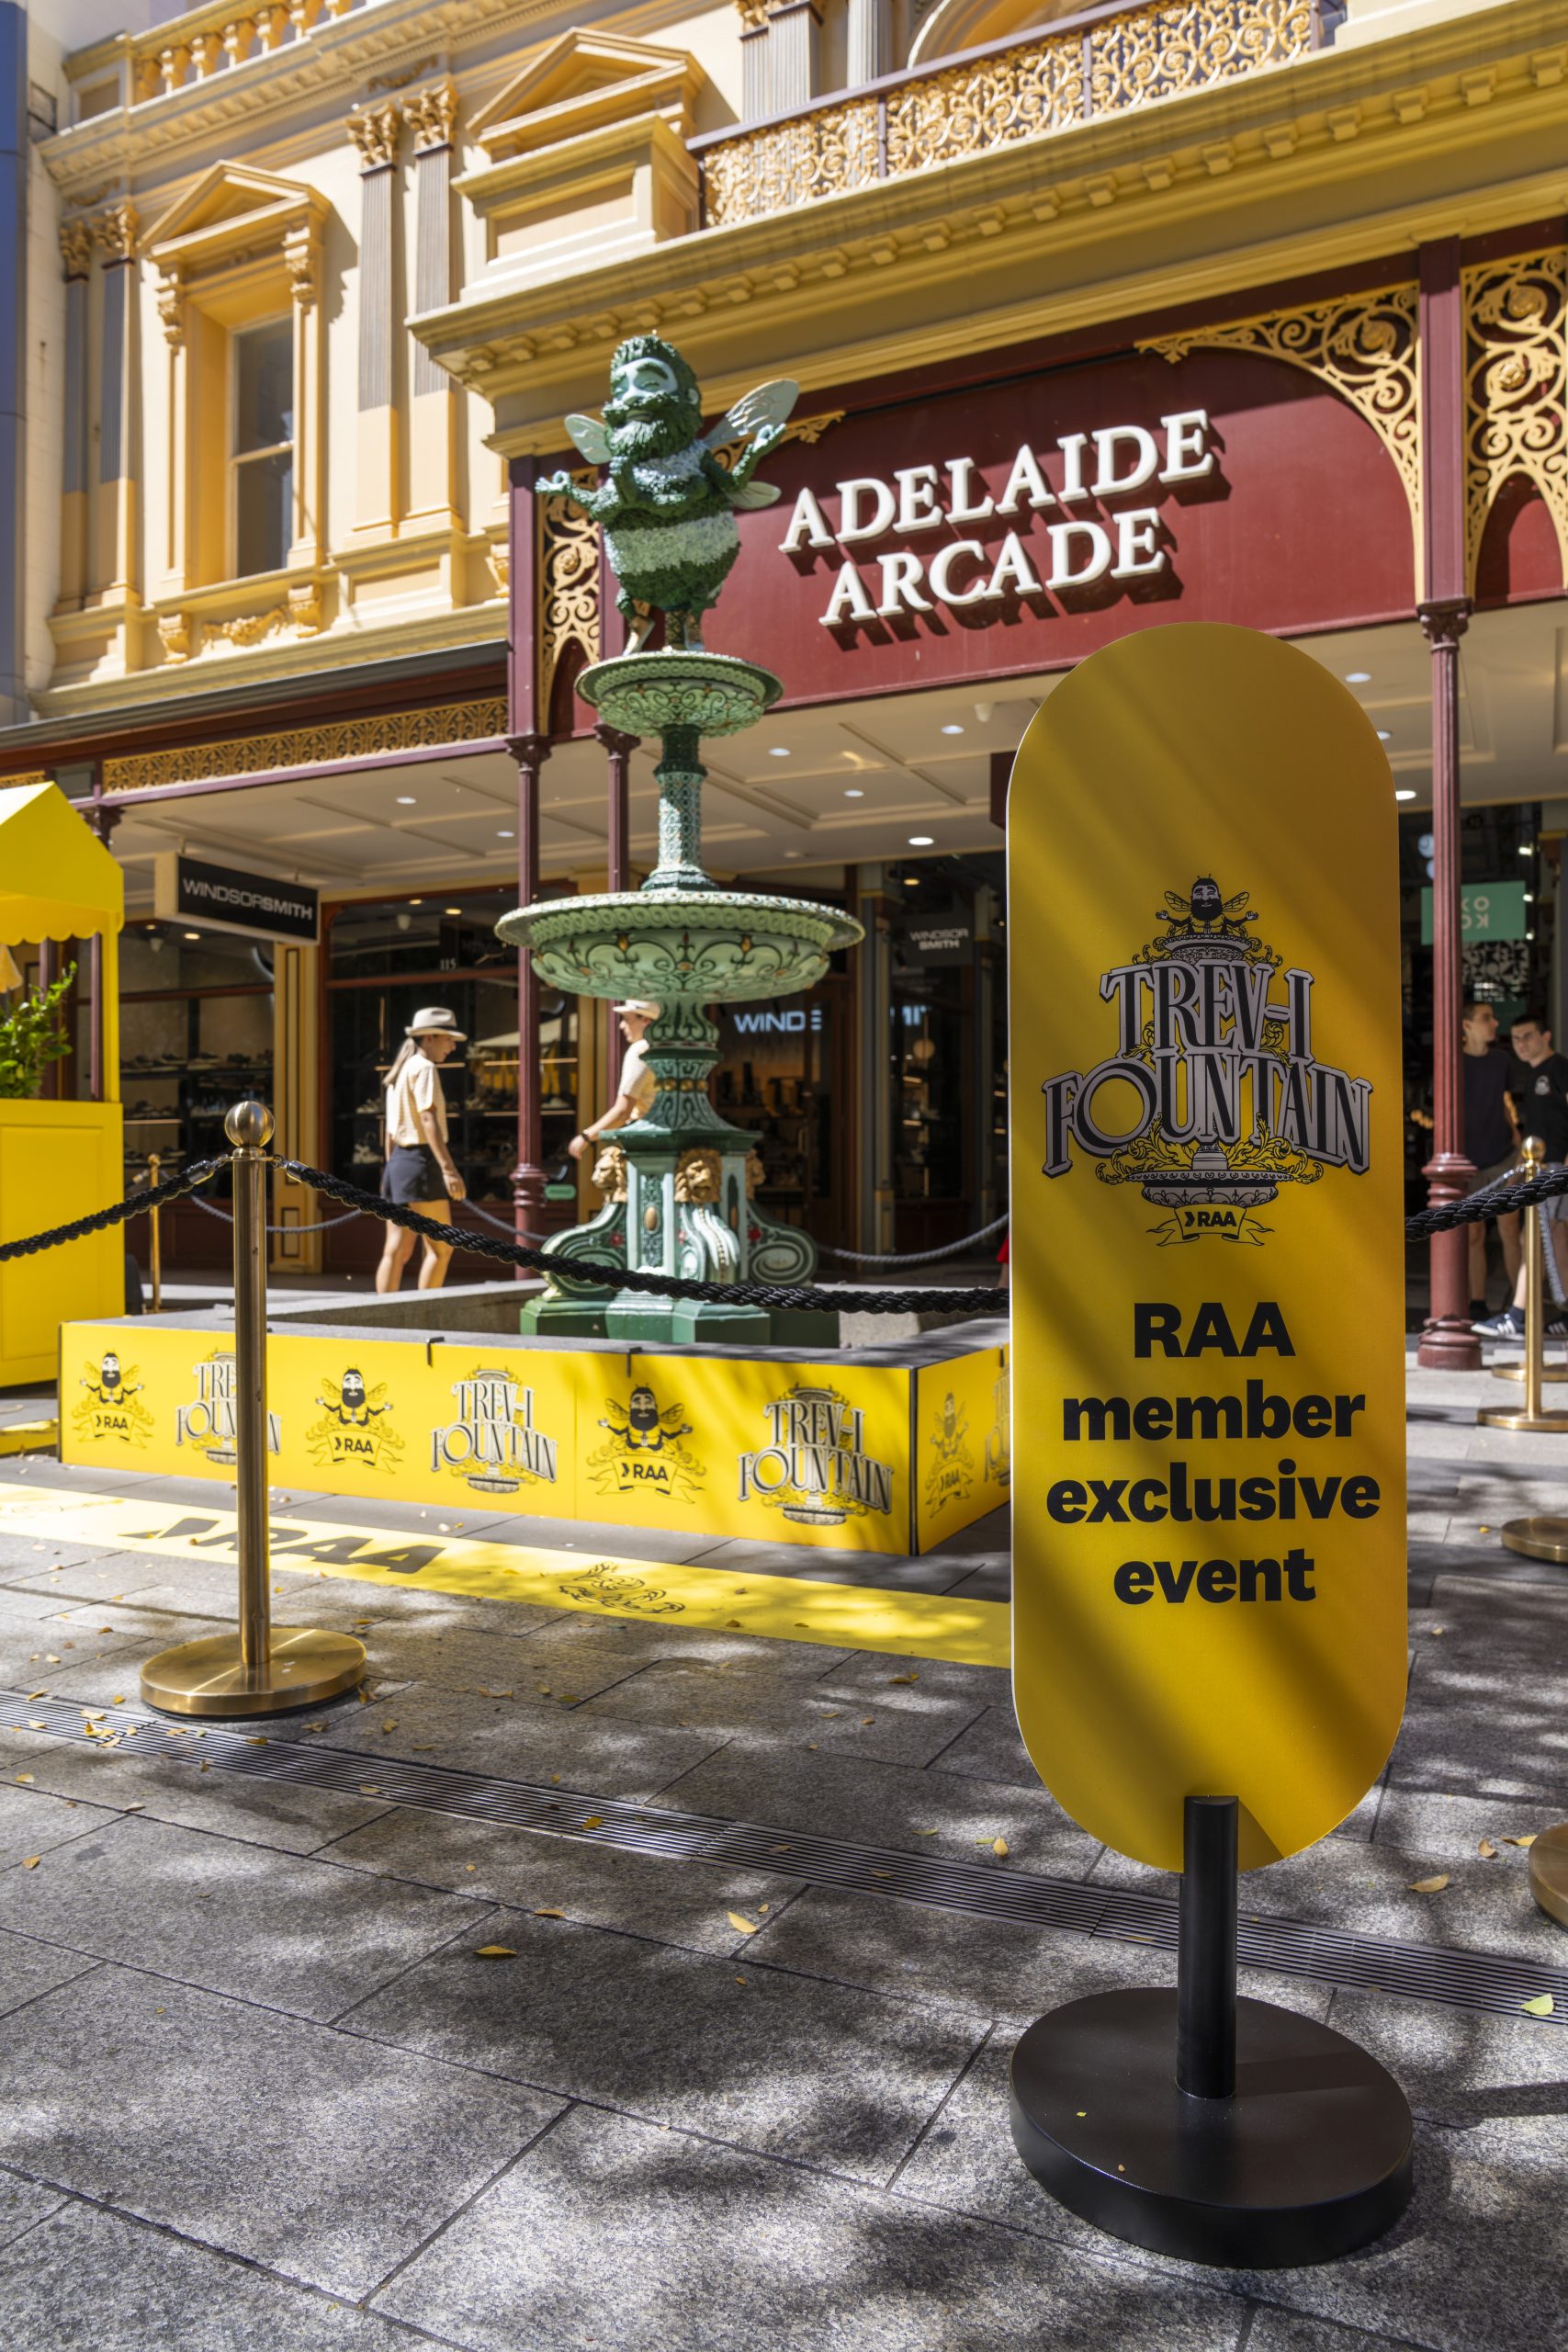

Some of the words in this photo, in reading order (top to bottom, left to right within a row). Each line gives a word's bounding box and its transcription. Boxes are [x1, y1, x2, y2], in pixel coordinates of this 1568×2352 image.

[779, 409, 1214, 553] ADELAIDE
[818, 507, 1165, 627] ARCADE
[909, 928, 969, 942] WINDSOR
[919, 939, 960, 950] SMITH
[440, 958, 457, 971] 115
[1100, 959, 1314, 1063] TREV-I
[1042, 1052, 1373, 1177] FOUNTAIN
[1197, 1210, 1237, 1228] RAA
[1134, 1301, 1297, 1359] RAA
[104, 1416, 129, 1430] RAA
[451, 1380, 536, 1430] TREV-I
[763, 1399, 865, 1454] TREV-I
[1063, 1379, 1366, 1442] member
[344, 1438, 375, 1454] RAA
[431, 1422, 558, 1484] FOUNTAIN
[633, 1464, 669, 1482] RAA
[738, 1443, 894, 1515] FOUNTAIN
[1046, 1458, 1381, 1524] exclusive
[1113, 1548, 1316, 1605] event
